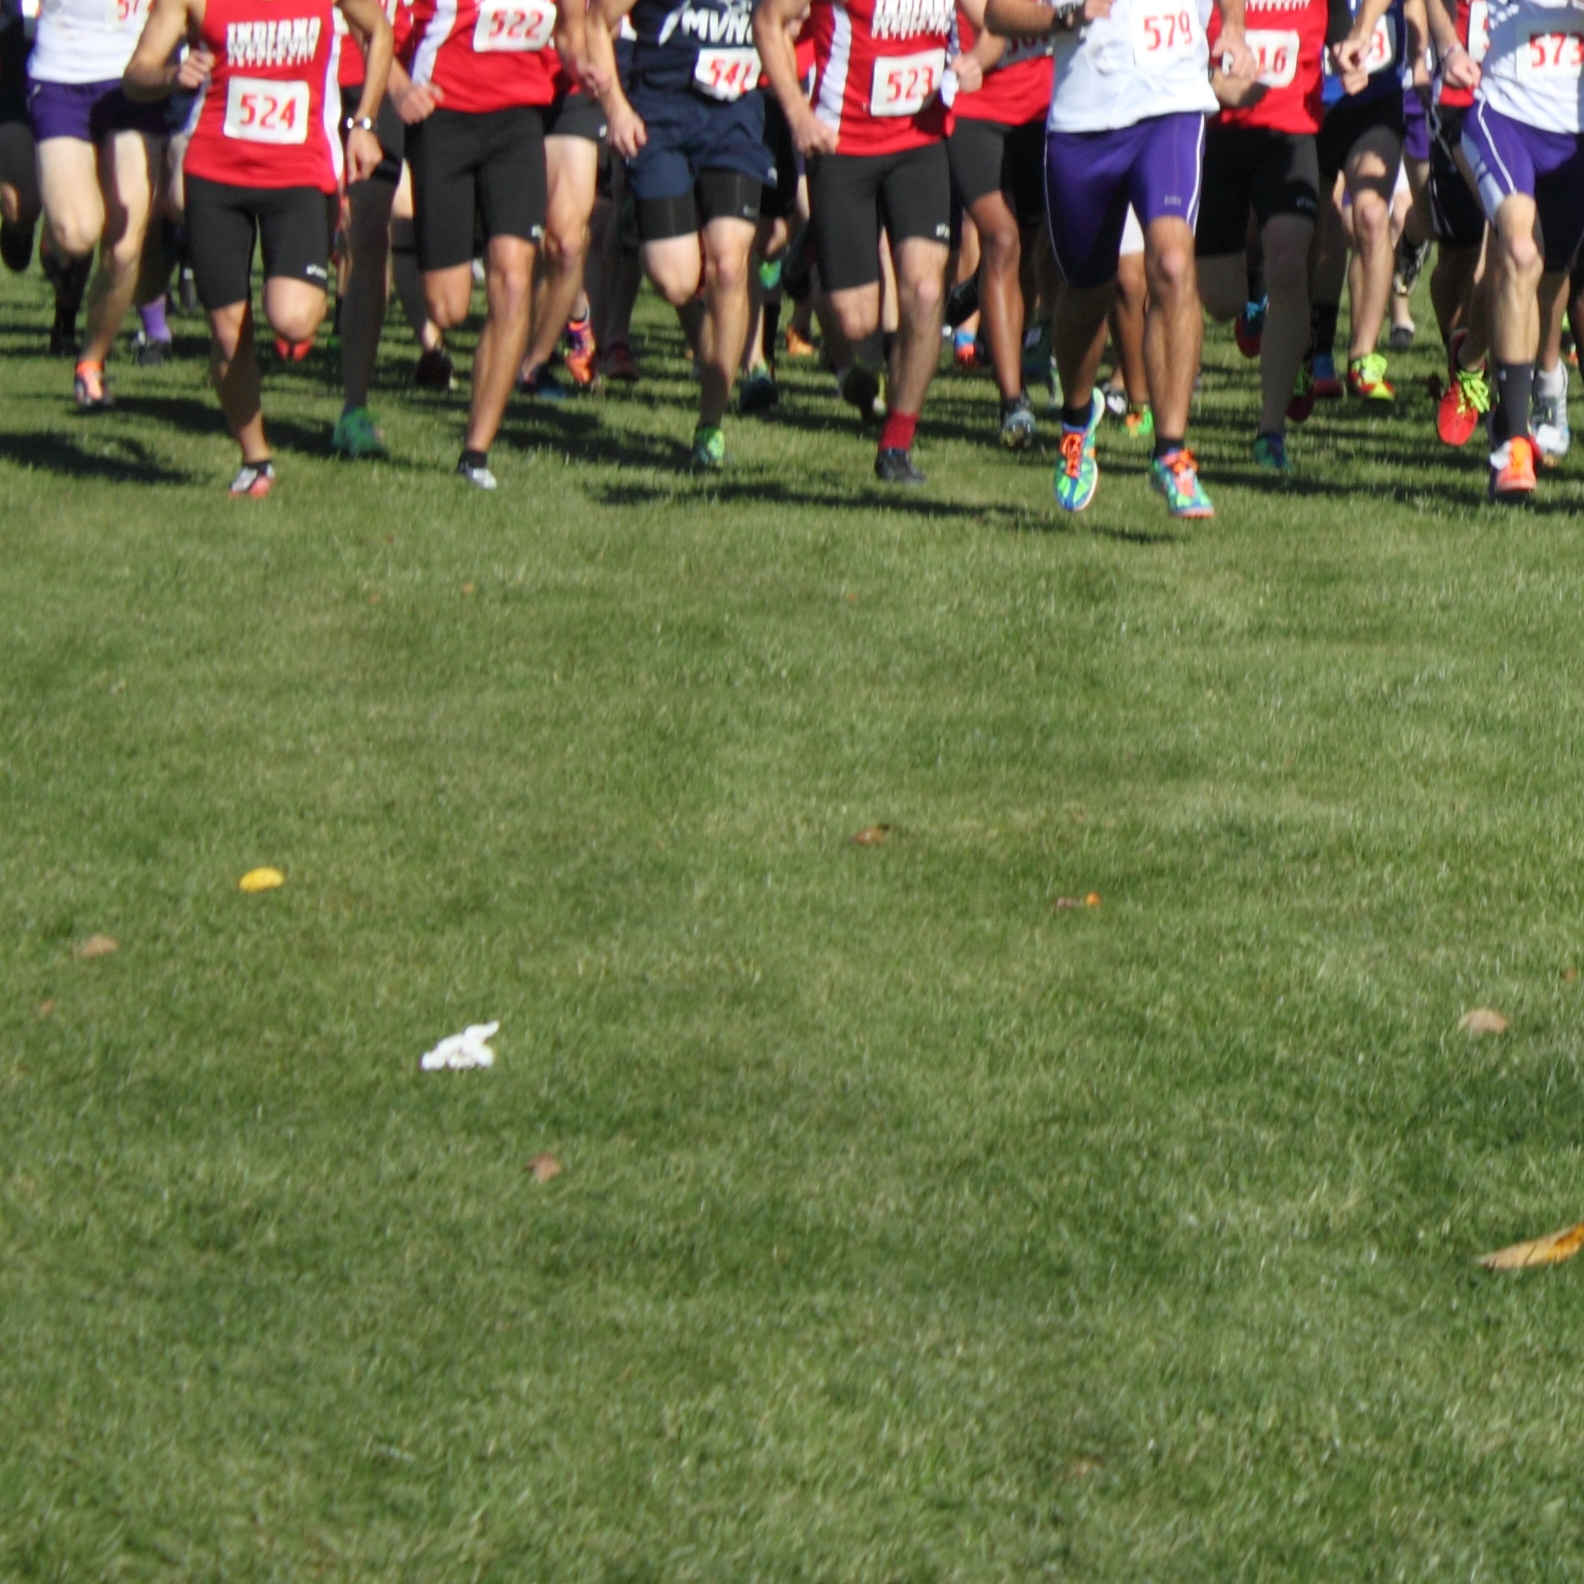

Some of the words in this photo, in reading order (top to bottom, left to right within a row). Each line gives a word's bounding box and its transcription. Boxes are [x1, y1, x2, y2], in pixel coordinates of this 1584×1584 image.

[488, 7, 544, 41] 522
[1143, 10, 1193, 52] 579
[1257, 45, 1288, 76] 16
[886, 64, 935, 104] 523
[238, 91, 298, 132] 524
